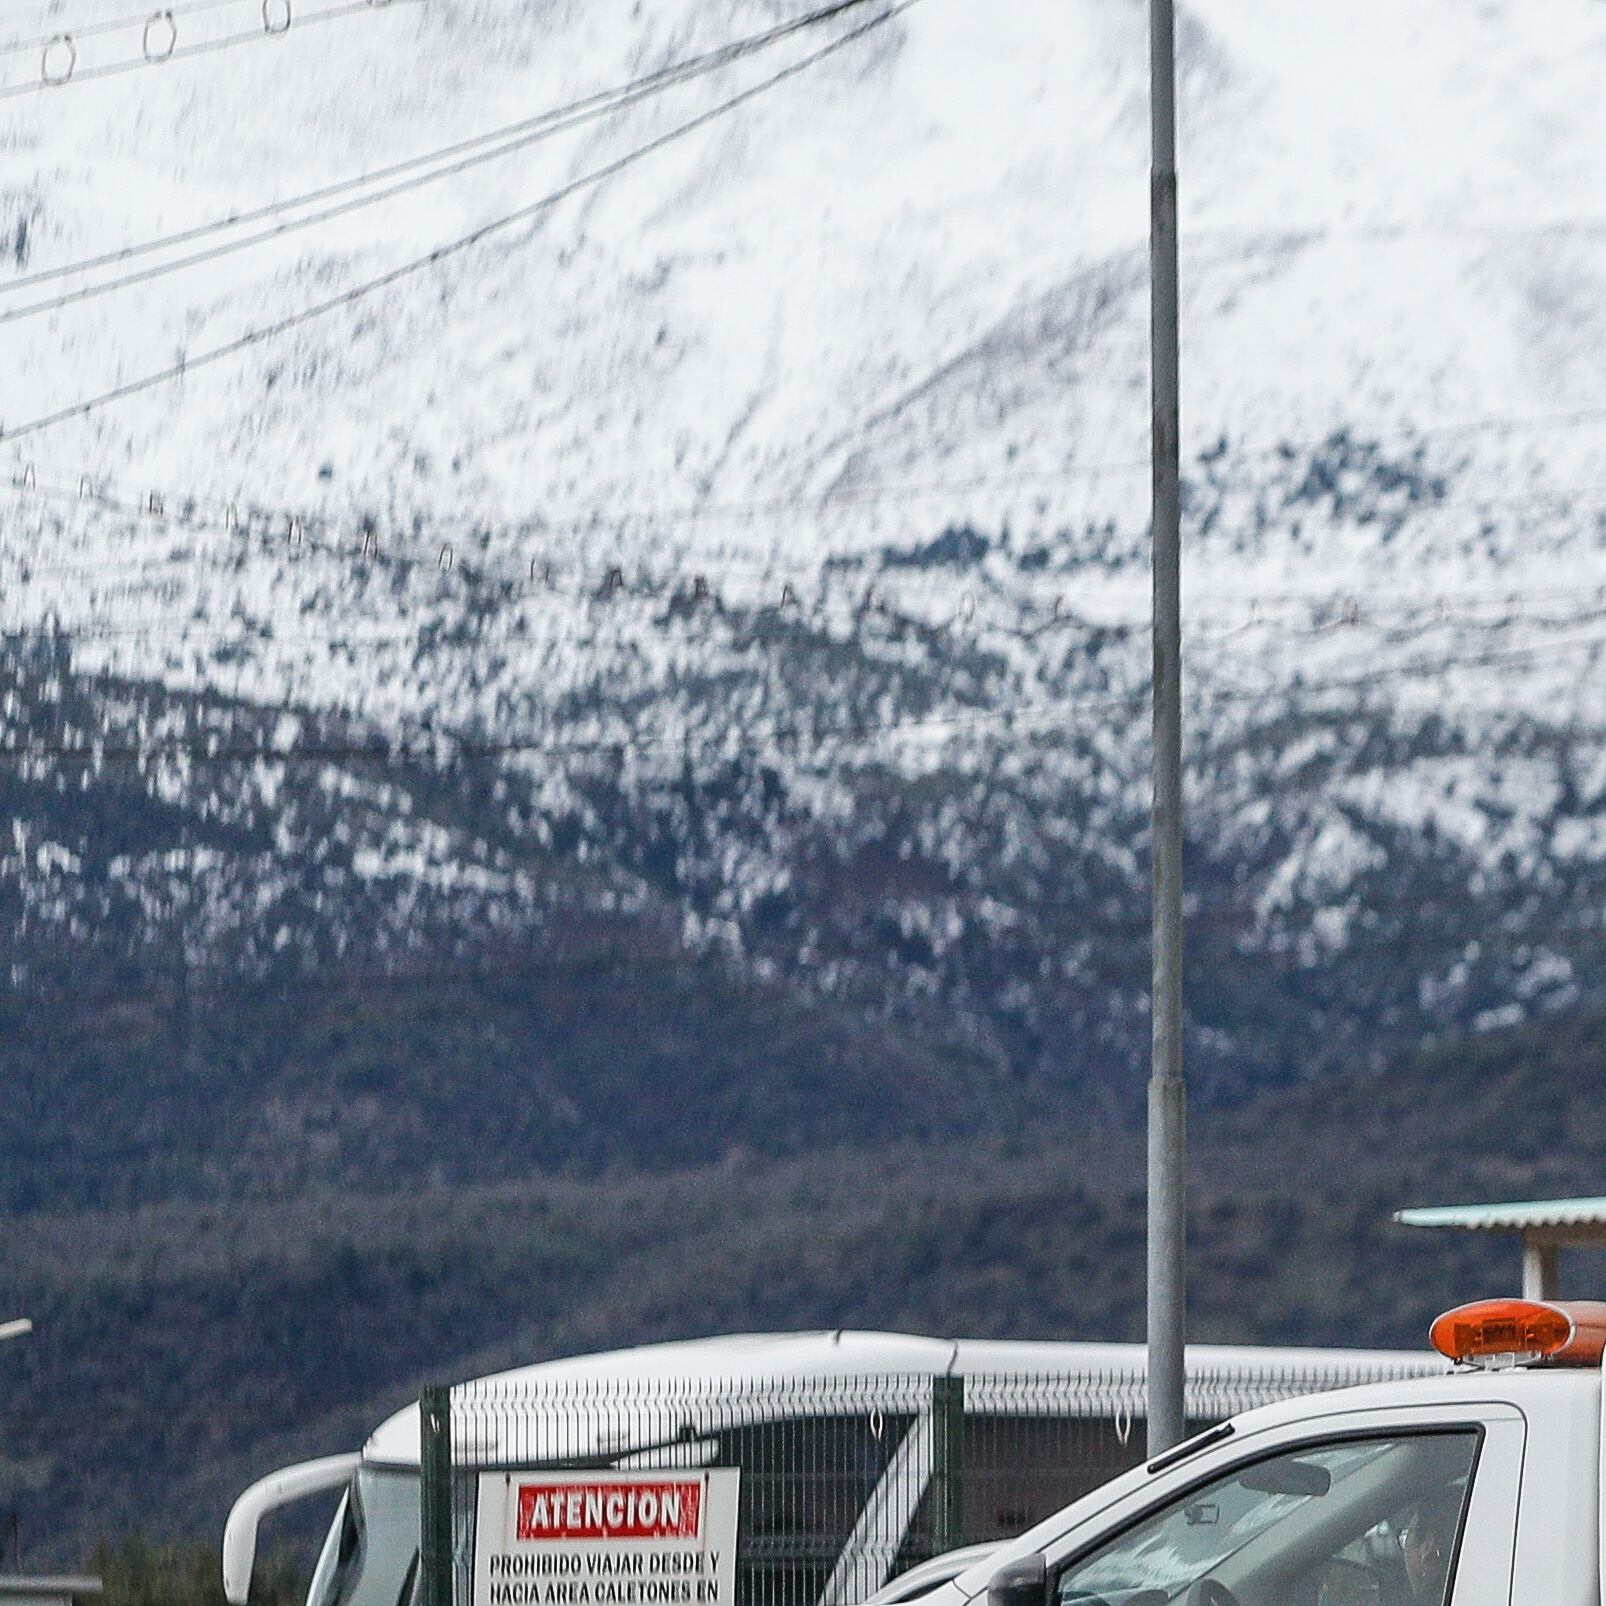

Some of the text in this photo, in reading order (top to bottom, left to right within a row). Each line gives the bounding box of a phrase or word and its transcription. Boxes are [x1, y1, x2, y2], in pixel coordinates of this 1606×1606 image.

[531, 1492, 682, 1529] ATENCION
[490, 1551, 720, 1577] PROHIBIDO VIAJAR DESDE Y
[490, 1579, 719, 1605] HACIA AREA CALETONES EN
